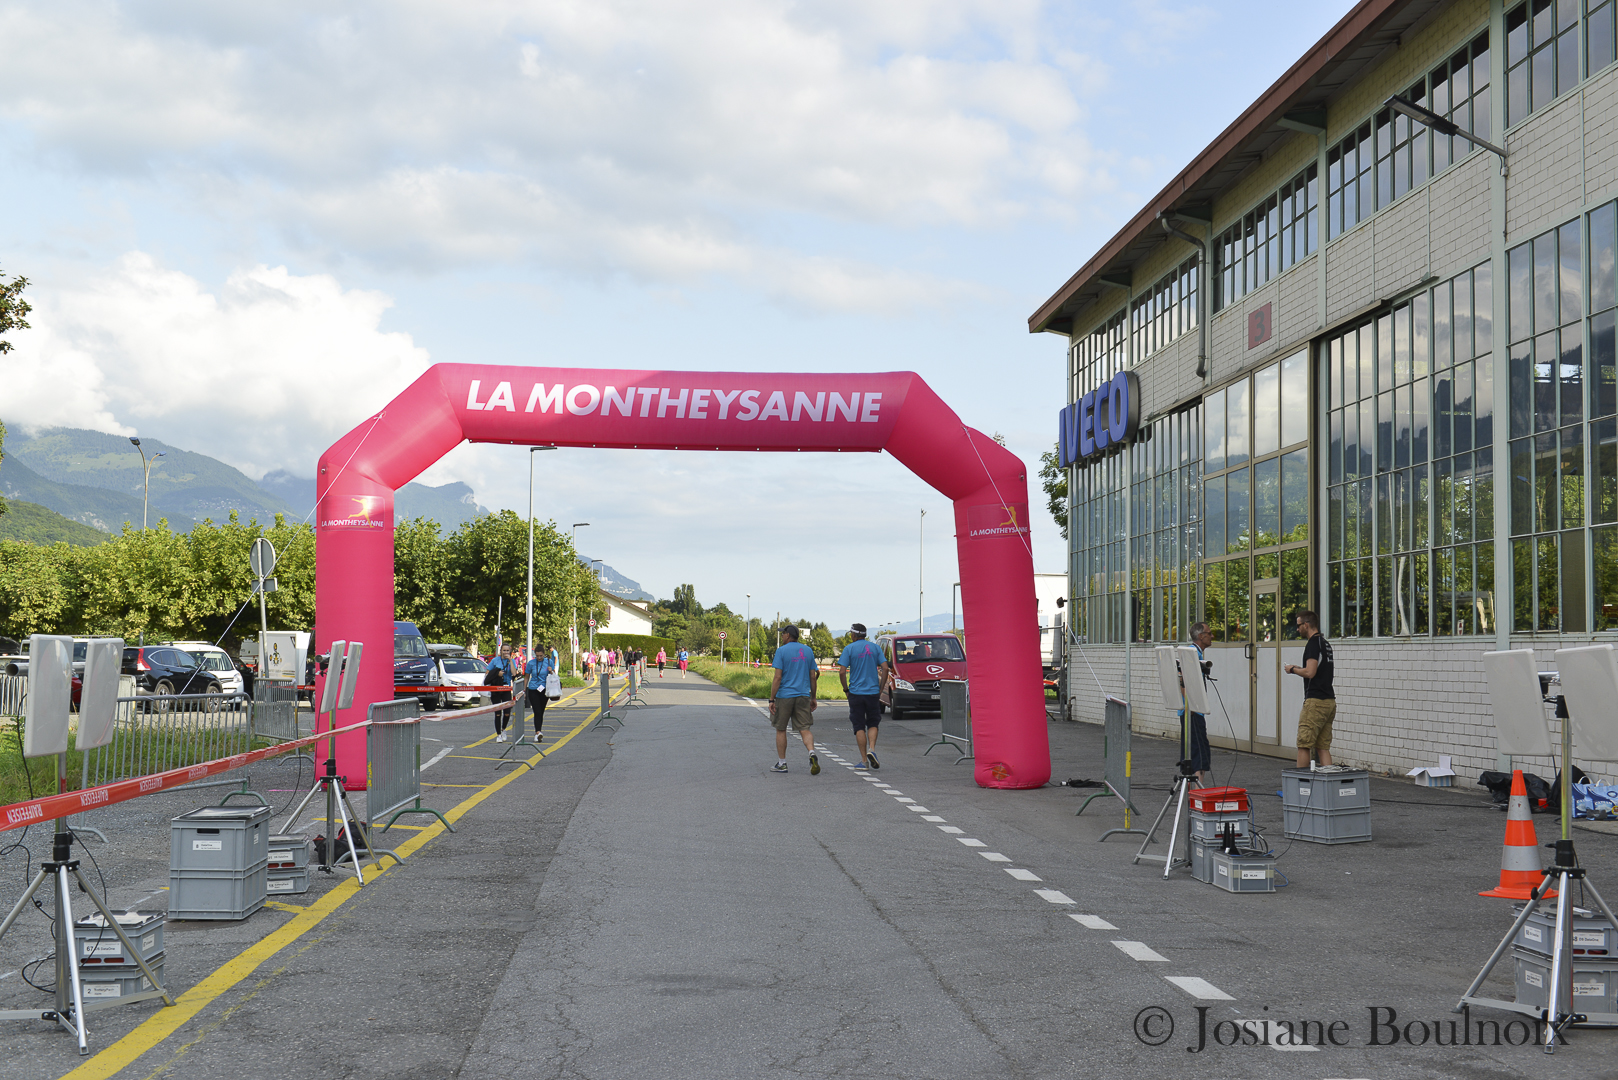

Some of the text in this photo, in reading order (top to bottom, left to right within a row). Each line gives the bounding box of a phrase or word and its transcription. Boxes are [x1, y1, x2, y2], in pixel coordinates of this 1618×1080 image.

[1254, 310, 1265, 343] 3
[465, 379, 883, 423] LA MONTHEYSANNE
[1059, 371, 1129, 469] IVECO
[328, 519, 384, 527] MONTHEYSANNE
[970, 526, 1028, 537] LA MONTHEYSANNE
[139, 777, 163, 792] RAIFFEISEN
[80, 789, 109, 806] RAIFFEISEN
[6, 804, 43, 823] RAIFFEISEN
